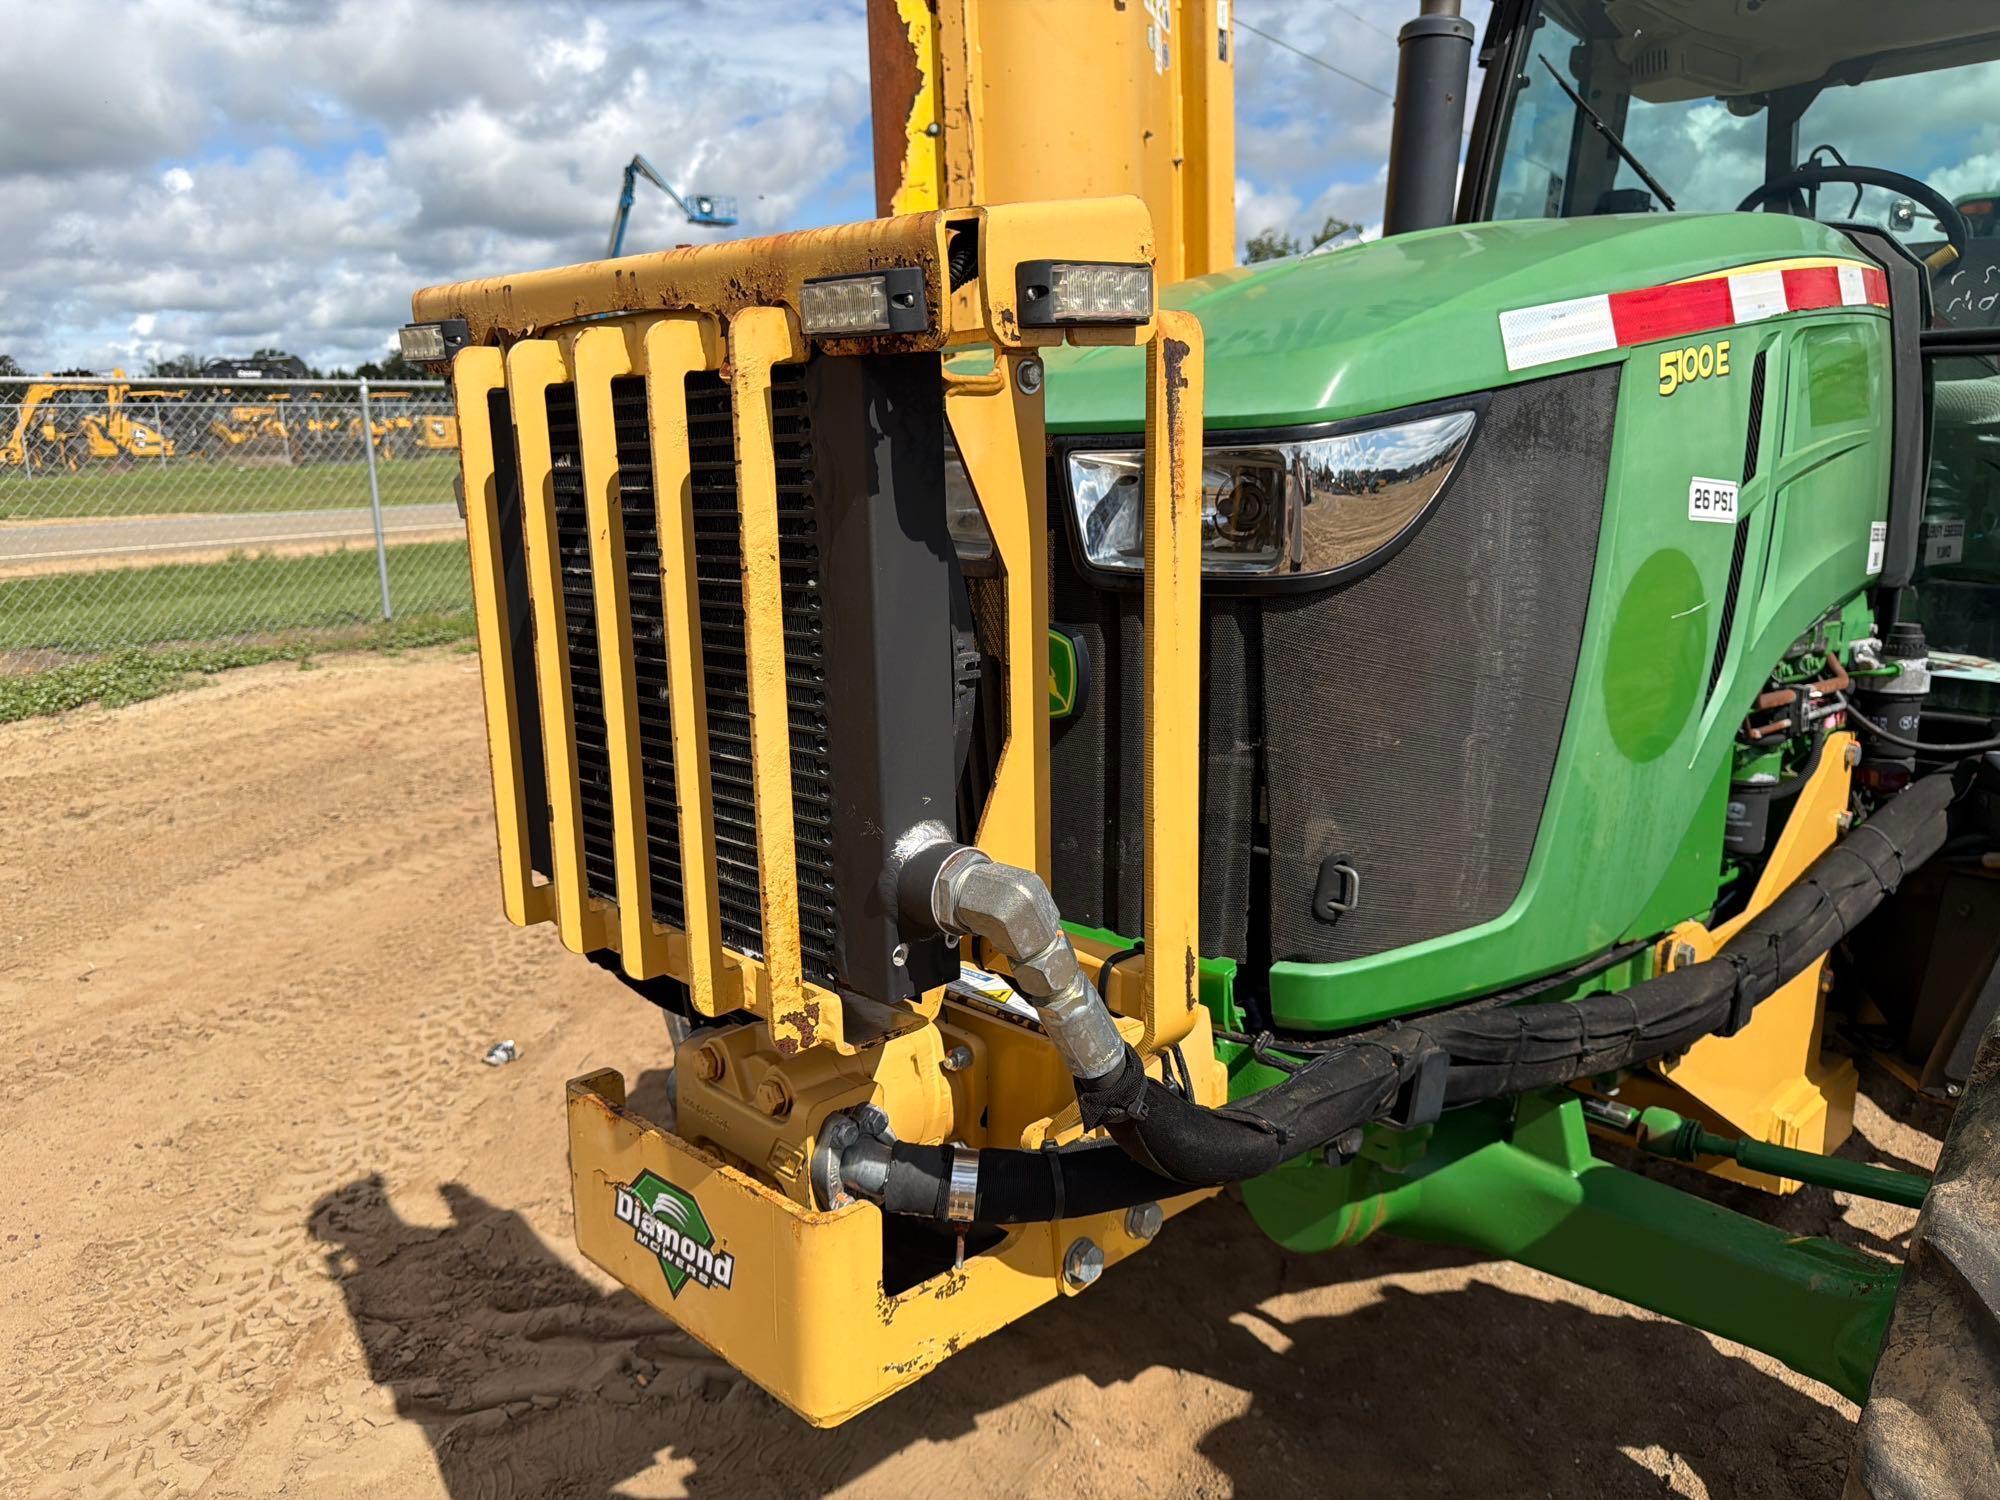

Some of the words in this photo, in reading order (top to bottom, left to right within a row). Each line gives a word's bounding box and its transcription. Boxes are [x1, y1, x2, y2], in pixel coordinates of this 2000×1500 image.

[1694, 488, 1711, 510] 26
[1713, 490, 1734, 512] PSI
[616, 1188, 733, 1286] Diamond
[636, 1232, 710, 1286] MOWERS
